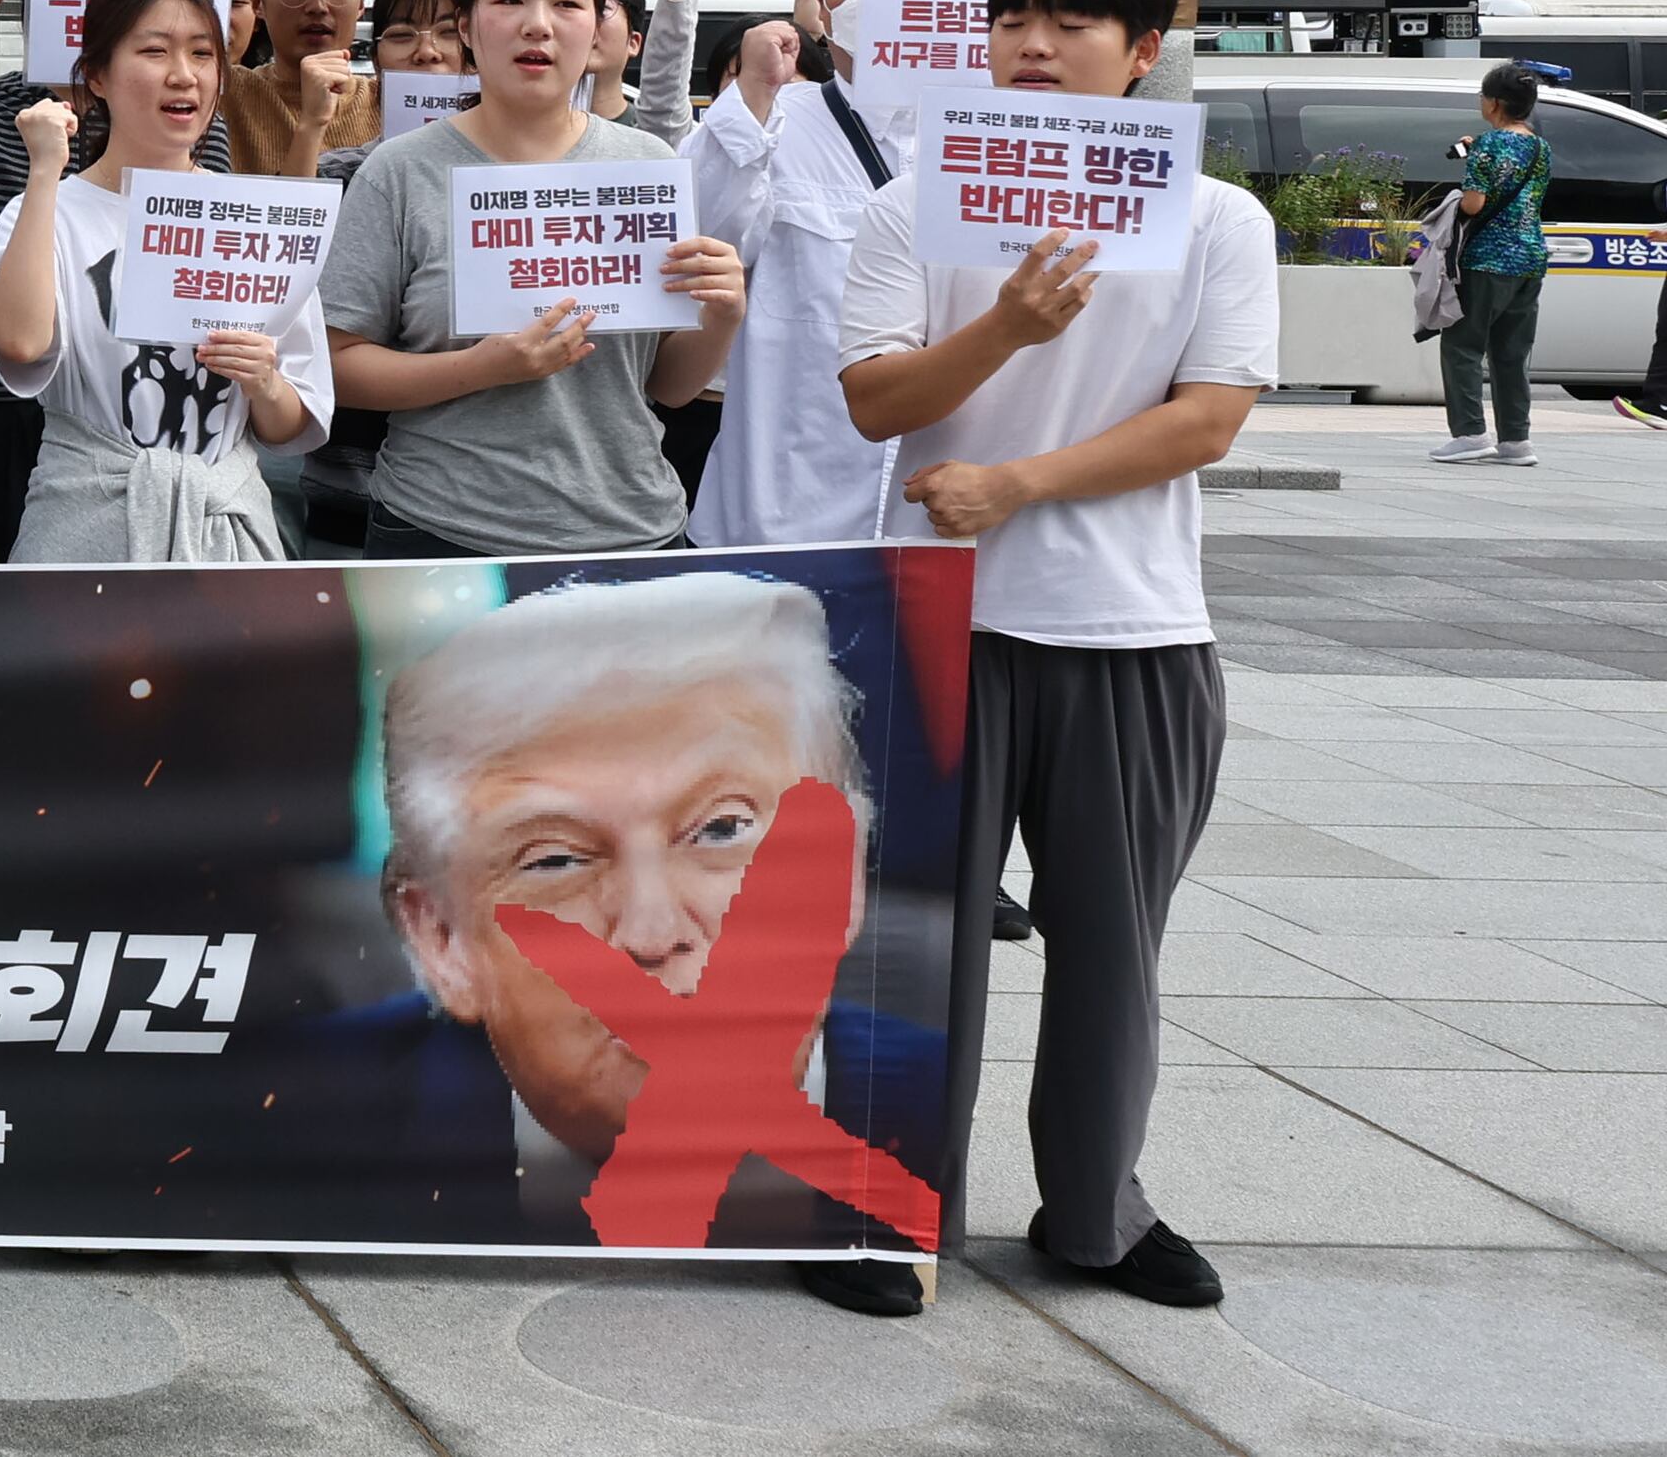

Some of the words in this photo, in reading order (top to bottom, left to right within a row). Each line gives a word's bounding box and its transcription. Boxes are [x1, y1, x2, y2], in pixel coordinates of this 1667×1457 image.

[943, 110, 973, 125] 우리
[977, 112, 1006, 128] 국민
[1009, 114, 1040, 130] 불법
[1110, 119, 1141, 137] 사과
[1144, 122, 1173, 140] 않는
[940, 134, 1069, 181] 트럼프
[1084, 143, 1173, 189] 방한
[145, 196, 202, 220] 이재명
[209, 200, 262, 224] 정부는
[267, 205, 328, 228] 불평등한
[469, 188, 528, 211] 이재명
[533, 187, 591, 209] 정부는
[597, 184, 677, 206] 불평등한
[959, 183, 1144, 235] 반대한다!
[142, 224, 204, 259] 대미
[213, 229, 271, 263] 투자
[276, 235, 322, 265] 계획
[470, 217, 533, 250] 대미
[543, 214, 605, 247] 투자
[615, 211, 679, 242] 계획
[172, 268, 290, 305] 철회하라!
[508, 253, 642, 290] 철회하라!
